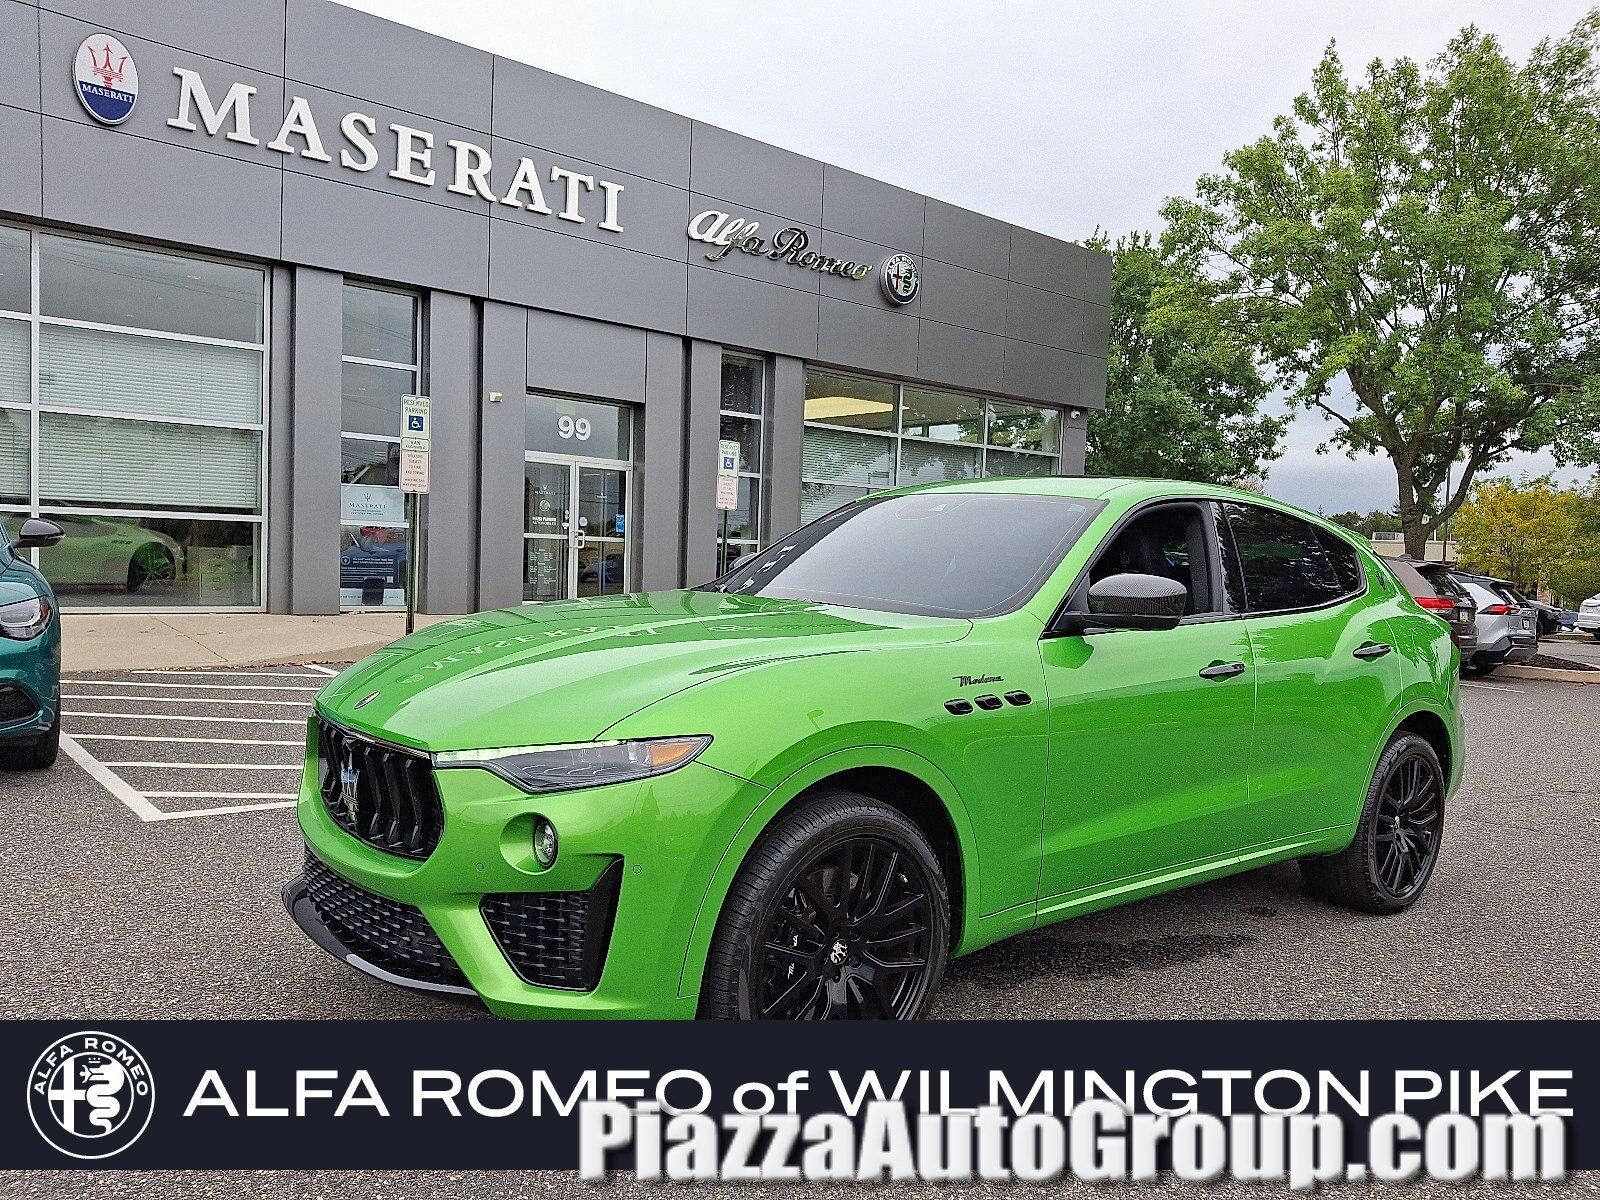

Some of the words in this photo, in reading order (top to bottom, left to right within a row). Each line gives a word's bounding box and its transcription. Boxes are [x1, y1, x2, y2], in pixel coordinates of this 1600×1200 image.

[82, 83, 133, 103] MASERATI
[166, 66, 625, 233] MASERATI
[688, 210, 767, 261] Alfa
[768, 227, 873, 281] Romeo
[404, 407, 428, 415] PARKING
[557, 415, 592, 441] 99
[952, 673, 1004, 687] Modena
